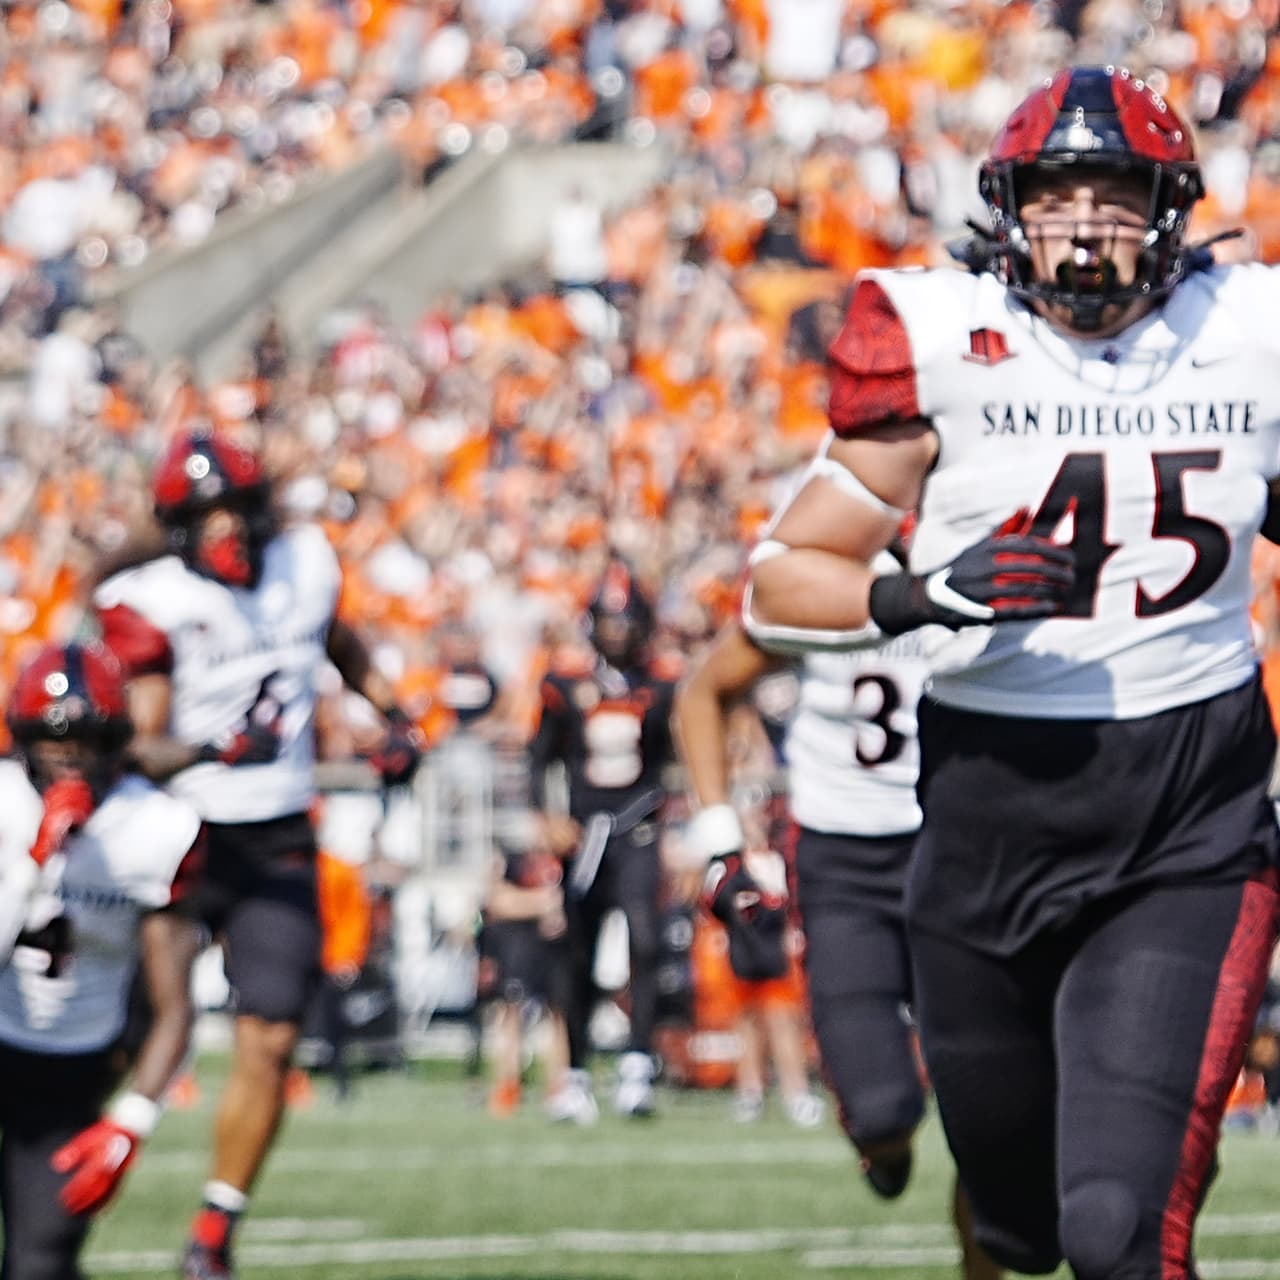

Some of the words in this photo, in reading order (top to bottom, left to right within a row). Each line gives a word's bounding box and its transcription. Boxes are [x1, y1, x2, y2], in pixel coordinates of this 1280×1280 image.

[982, 401, 1040, 435] SAN
[1056, 403, 1155, 435] DIEGO
[1168, 400, 1258, 434] STATE
[1026, 450, 1231, 620] 45
